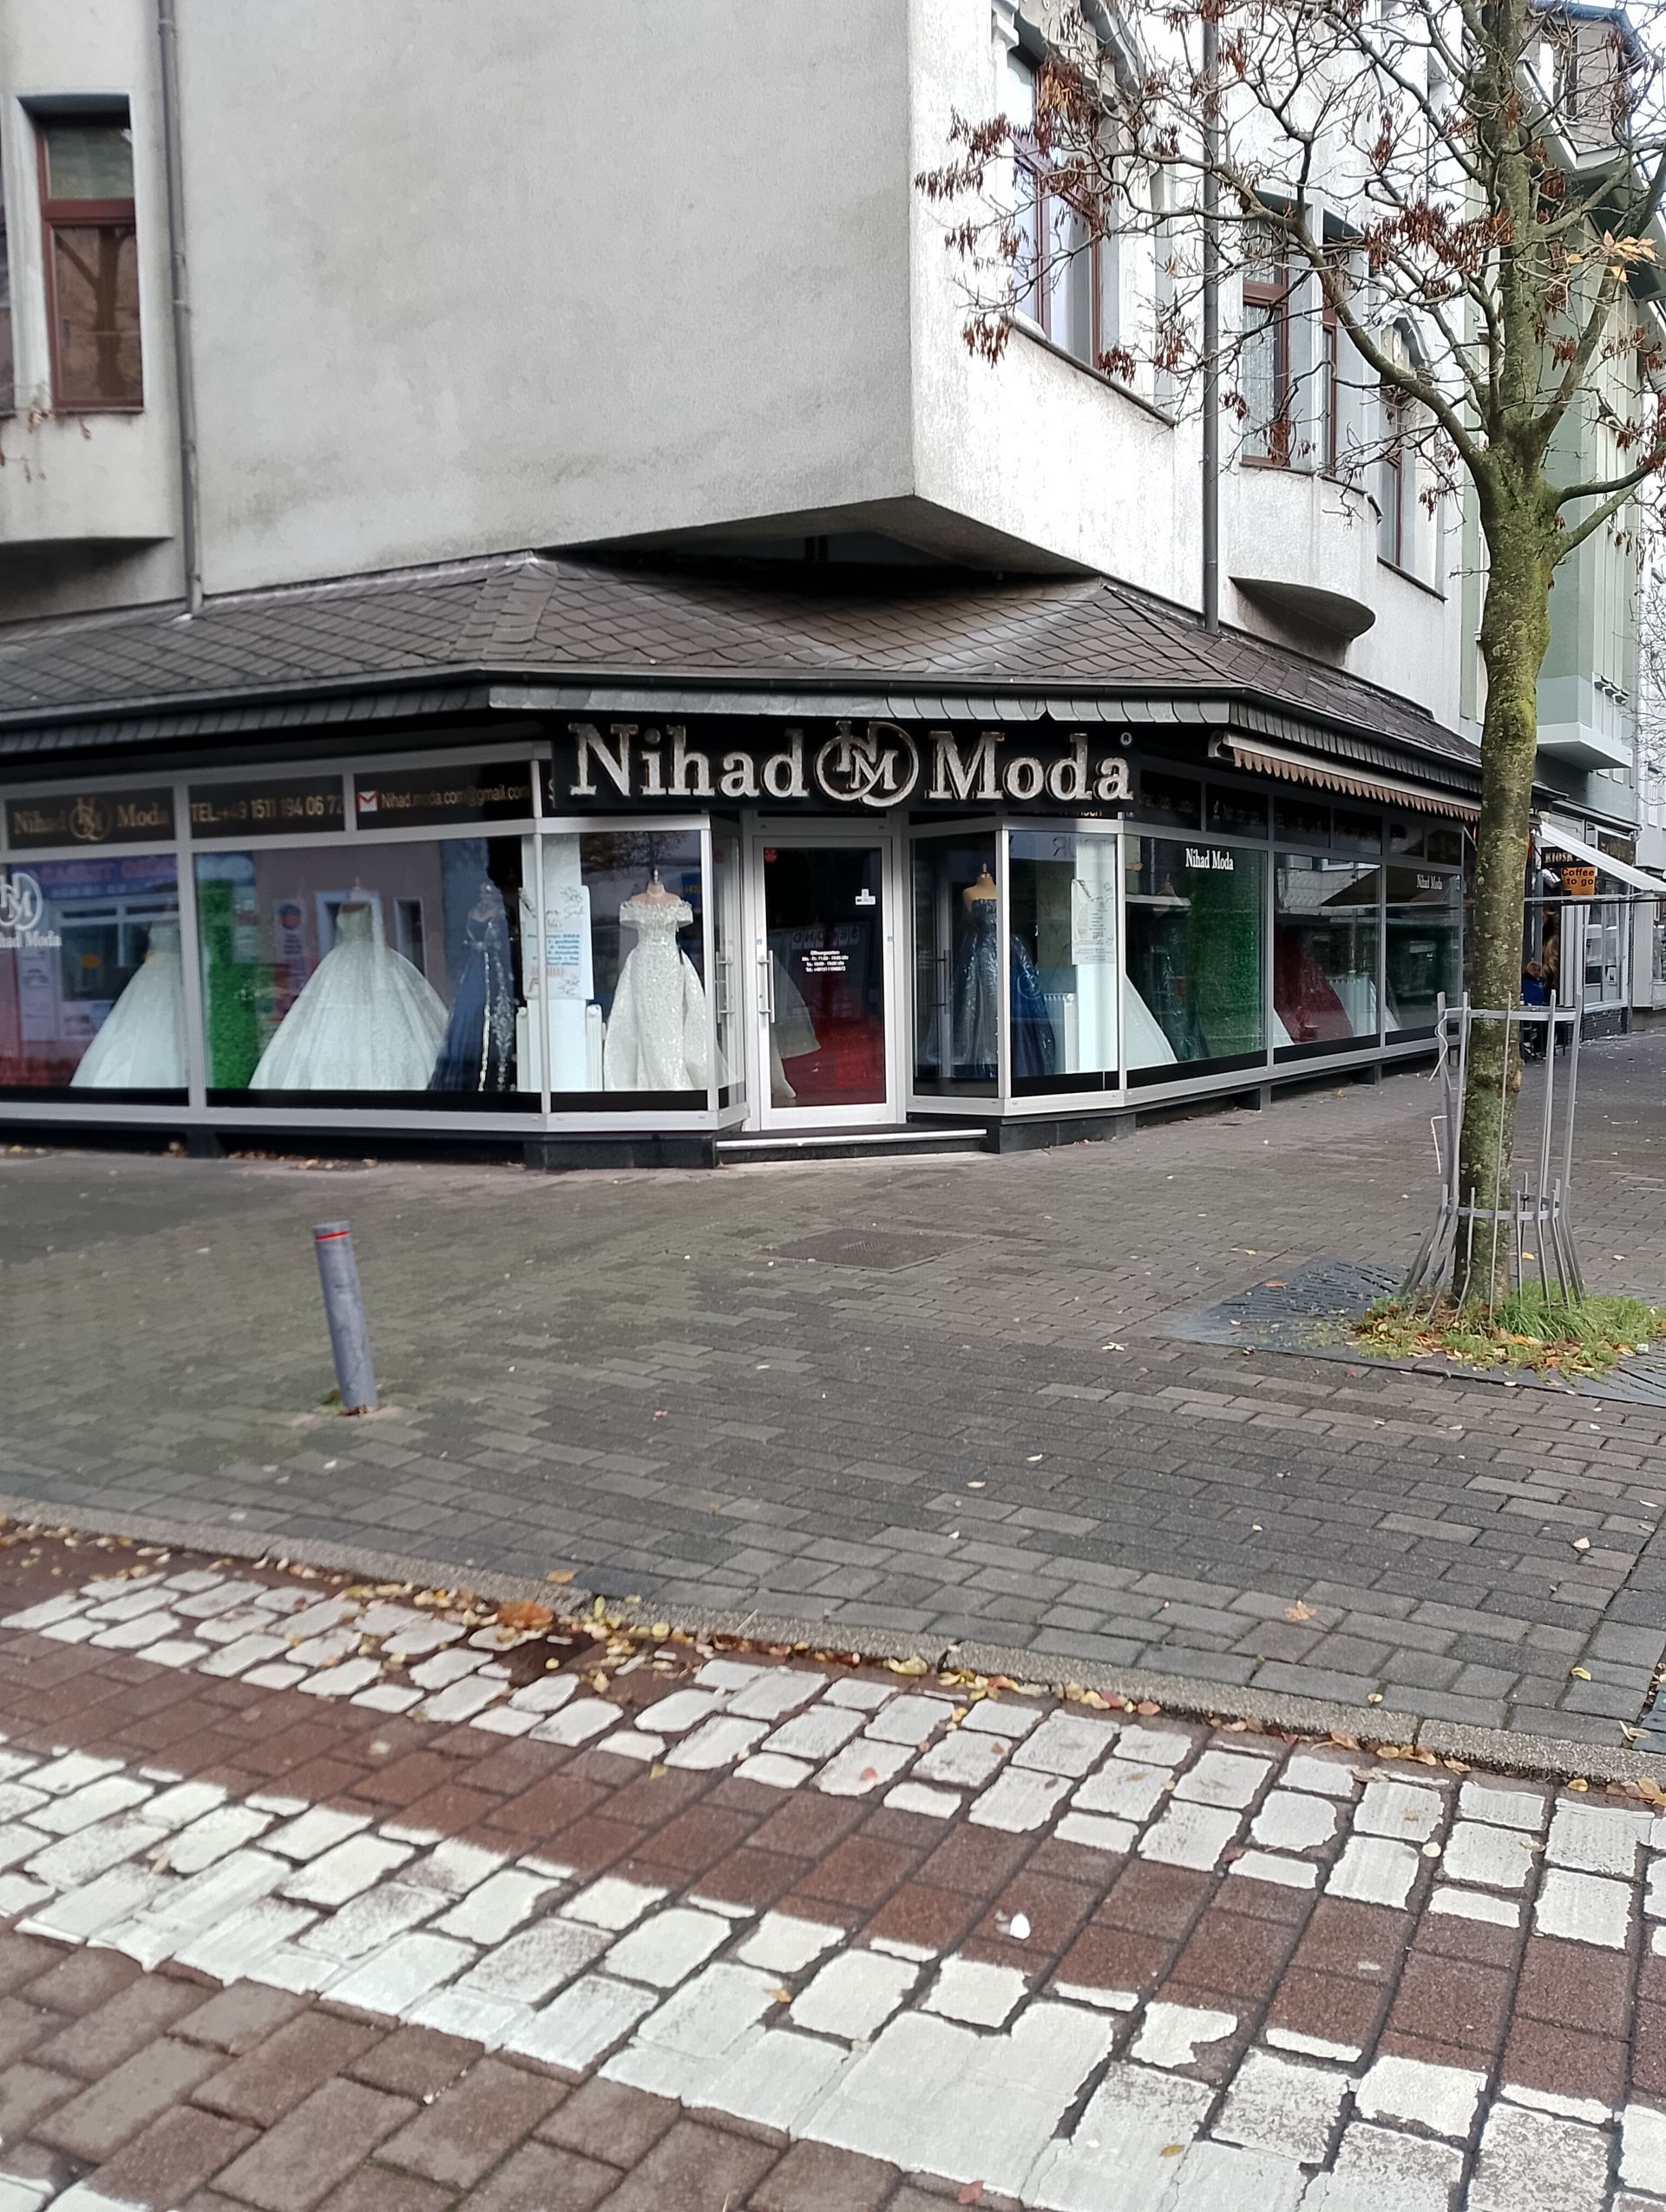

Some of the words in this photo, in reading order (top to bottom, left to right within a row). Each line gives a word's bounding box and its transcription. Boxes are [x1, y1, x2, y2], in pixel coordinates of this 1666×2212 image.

[567, 722, 810, 797] Nihad
[925, 730, 1134, 801] Moda
[1185, 847, 1210, 869] Nihad
[1211, 850, 1234, 871] Moda
[1562, 868, 1595, 877] Coffee
[1581, 879, 1594, 887] go
